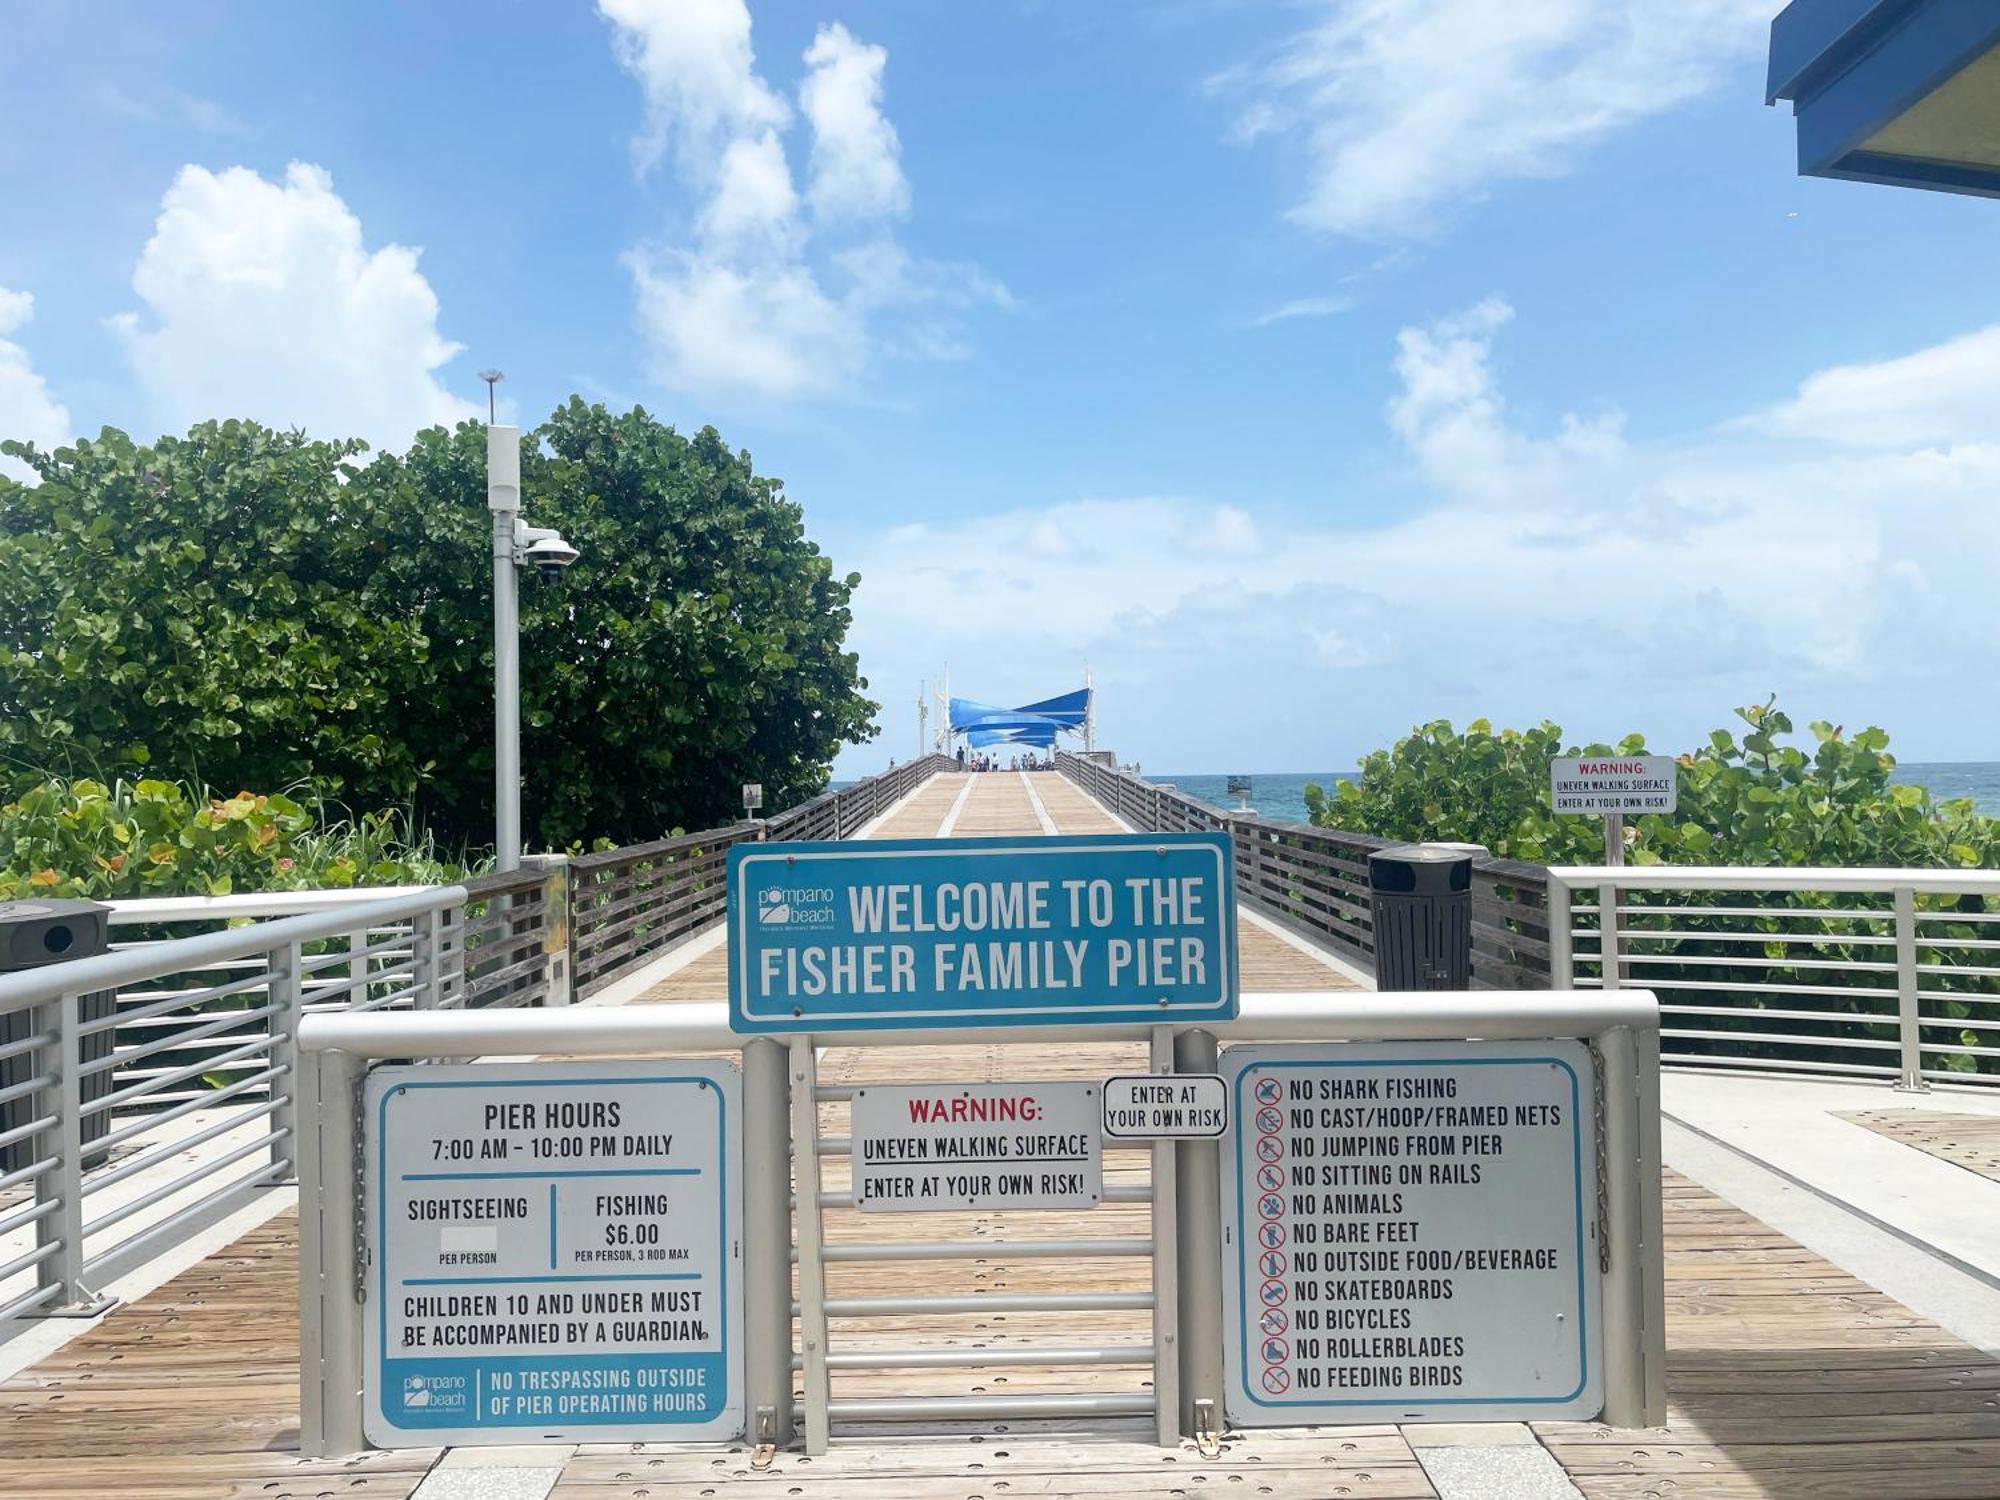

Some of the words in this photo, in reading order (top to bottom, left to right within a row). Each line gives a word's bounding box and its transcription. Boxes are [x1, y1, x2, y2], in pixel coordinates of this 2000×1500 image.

[1557, 781, 1589, 790] UNEVEN
[1592, 780, 1628, 790] WALKING
[1632, 779, 1670, 789] SURFACE
[1558, 799, 1582, 808] ENTER
[1585, 799, 1594, 808] AT
[1599, 798, 1620, 808] YOUR
[1624, 798, 1641, 807] OWN
[1645, 798, 1667, 807] RISK!
[759, 888, 833, 906] pompano
[848, 882, 1051, 933] WELCOME
[1061, 879, 1114, 927] TO
[1126, 877, 1205, 926] THE
[791, 906, 833, 923] beach
[759, 945, 916, 996] FISHER
[934, 940, 1089, 991] FAMILY
[1108, 937, 1207, 987] PIER
[1131, 1087, 1174, 1104] ENTER
[1180, 1086, 1197, 1103] AT
[1289, 1079, 1313, 1099] NO
[1319, 1080, 1379, 1099] SHARK
[1386, 1078, 1457, 1099] FISHING
[484, 1104, 537, 1130] PIER
[545, 1102, 621, 1128] HOURS
[908, 1098, 1043, 1123] WARNING:
[1108, 1110, 1147, 1128] YOUR
[1152, 1110, 1183, 1127] OWN
[1188, 1109, 1221, 1127] RISK
[1290, 1108, 1314, 1129] NO
[1320, 1106, 1508, 1128] CAST/HOOP/FRAMED
[1515, 1105, 1561, 1126] NETS
[432, 1139, 473, 1160] 7:00
[480, 1138, 508, 1159] AM
[530, 1137, 583, 1158] 10:00
[589, 1136, 616, 1157] PM
[623, 1135, 673, 1156] DAILY
[864, 1138, 928, 1159] UNEVEN
[935, 1136, 1008, 1158] WALKING
[1015, 1135, 1089, 1156] SURFACE
[1291, 1137, 1314, 1158] NO
[1322, 1136, 1399, 1158] JUMPING
[1406, 1136, 1455, 1157] FROM
[1462, 1135, 1503, 1155] PIER
[1291, 1165, 1315, 1186] NO
[1322, 1165, 1392, 1186] SITTING
[1399, 1164, 1423, 1185] ON
[1429, 1163, 1481, 1184] RAILS
[864, 1178, 914, 1198] ENTER
[921, 1177, 940, 1197] AT
[947, 1176, 991, 1197] YOUR
[999, 1175, 1033, 1195] OWN
[1041, 1174, 1084, 1194] RISK!
[407, 1198, 528, 1220] SIGHTSEEING
[596, 1195, 668, 1217] FISHING
[1292, 1195, 1316, 1216] NO
[1323, 1194, 1403, 1215] ANIMALS
[605, 1223, 659, 1246] $6.00
[1293, 1224, 1317, 1244] NO
[1323, 1224, 1371, 1243] BARE
[1377, 1222, 1419, 1242] FEET
[439, 1254, 458, 1265] PER
[460, 1252, 497, 1264] PERSON
[575, 1250, 593, 1261] PER
[638, 1250, 645, 1260] 3
[647, 1250, 666, 1260] ROD
[668, 1249, 689, 1260] MAX
[1294, 1252, 1318, 1273] NO
[1324, 1252, 1400, 1273] OUTSIDE
[1406, 1249, 1558, 1272] FOOD/BEVERAGE
[1295, 1281, 1318, 1302] NO
[1324, 1280, 1453, 1301] SKATEBOARDS
[404, 1296, 498, 1318] CHILDREN
[506, 1295, 528, 1316] 10
[536, 1294, 574, 1315] AND
[581, 1293, 643, 1314] UNDER
[650, 1291, 702, 1312] MUST
[1295, 1310, 1319, 1330] NO
[1326, 1309, 1411, 1330] BICYCLES
[405, 1325, 426, 1347] BE
[432, 1324, 560, 1346] ACCOMPANIED
[567, 1323, 588, 1344] BY
[595, 1323, 607, 1343] A
[1296, 1339, 1320, 1359] NO
[1327, 1337, 1464, 1359] ROLLERBLADES
[491, 1371, 513, 1391] NO
[519, 1369, 631, 1390] TRESPASSING
[637, 1368, 706, 1387] OUTSIDE
[1298, 1368, 1321, 1388] NO
[1328, 1367, 1402, 1388] FEEDING
[1409, 1366, 1463, 1387] BIRDS
[431, 1392, 465, 1405] beach
[491, 1396, 509, 1415] OF
[517, 1394, 553, 1415] PIER
[559, 1393, 648, 1415] OPERATING
[653, 1392, 706, 1412] HOURS
